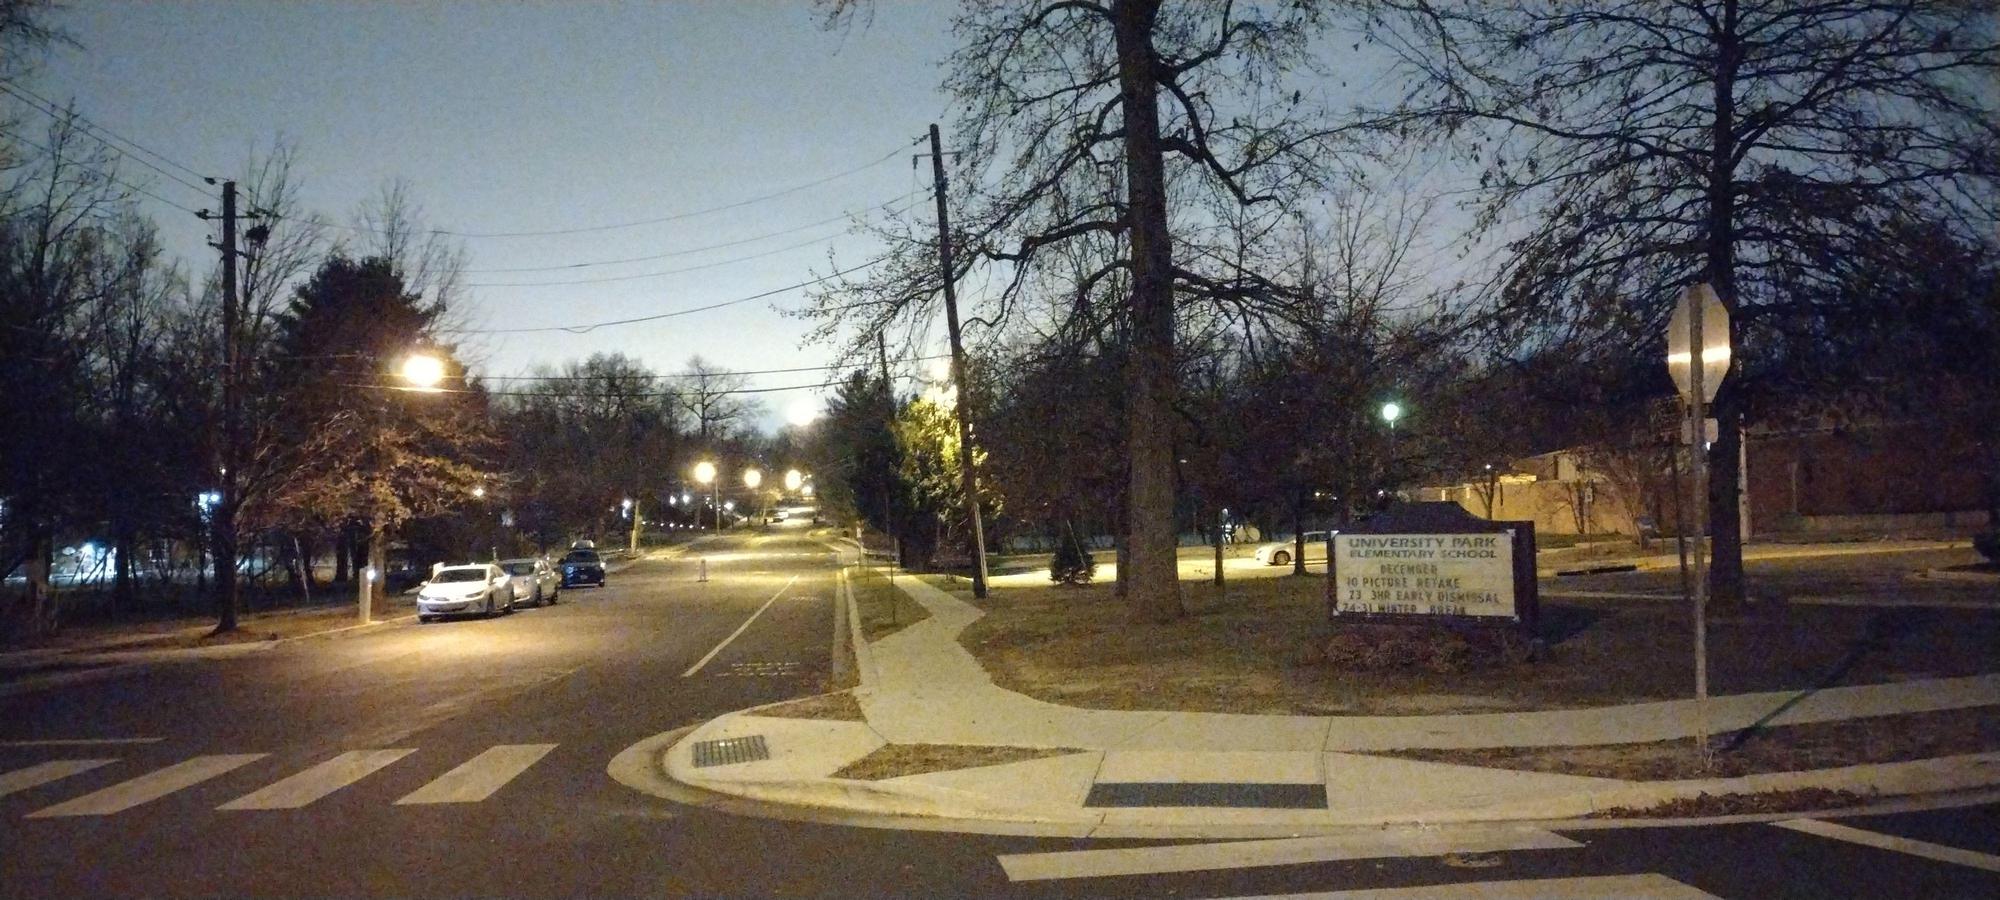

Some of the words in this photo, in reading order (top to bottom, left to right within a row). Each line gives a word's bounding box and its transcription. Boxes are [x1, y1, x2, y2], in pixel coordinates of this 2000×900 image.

[1349, 537, 1445, 548] UNIVERSITY
[1452, 537, 1497, 548] PARK
[1350, 550, 1435, 559] ELEMENTARY
[1441, 550, 1498, 559] SCHOOL
[1380, 564, 1438, 574] DECEMBER
[1347, 577, 1358, 587] 10
[1363, 577, 1408, 588] PICTURE
[1416, 578, 1460, 589] RETAKE
[1349, 590, 1362, 600] 23
[1371, 590, 1391, 601] 3HR
[1396, 590, 1433, 601] EARLY
[1437, 591, 1500, 604] DISMISSAL
[1378, 603, 1417, 614] WINTER
[1429, 605, 1466, 616] BREAK
